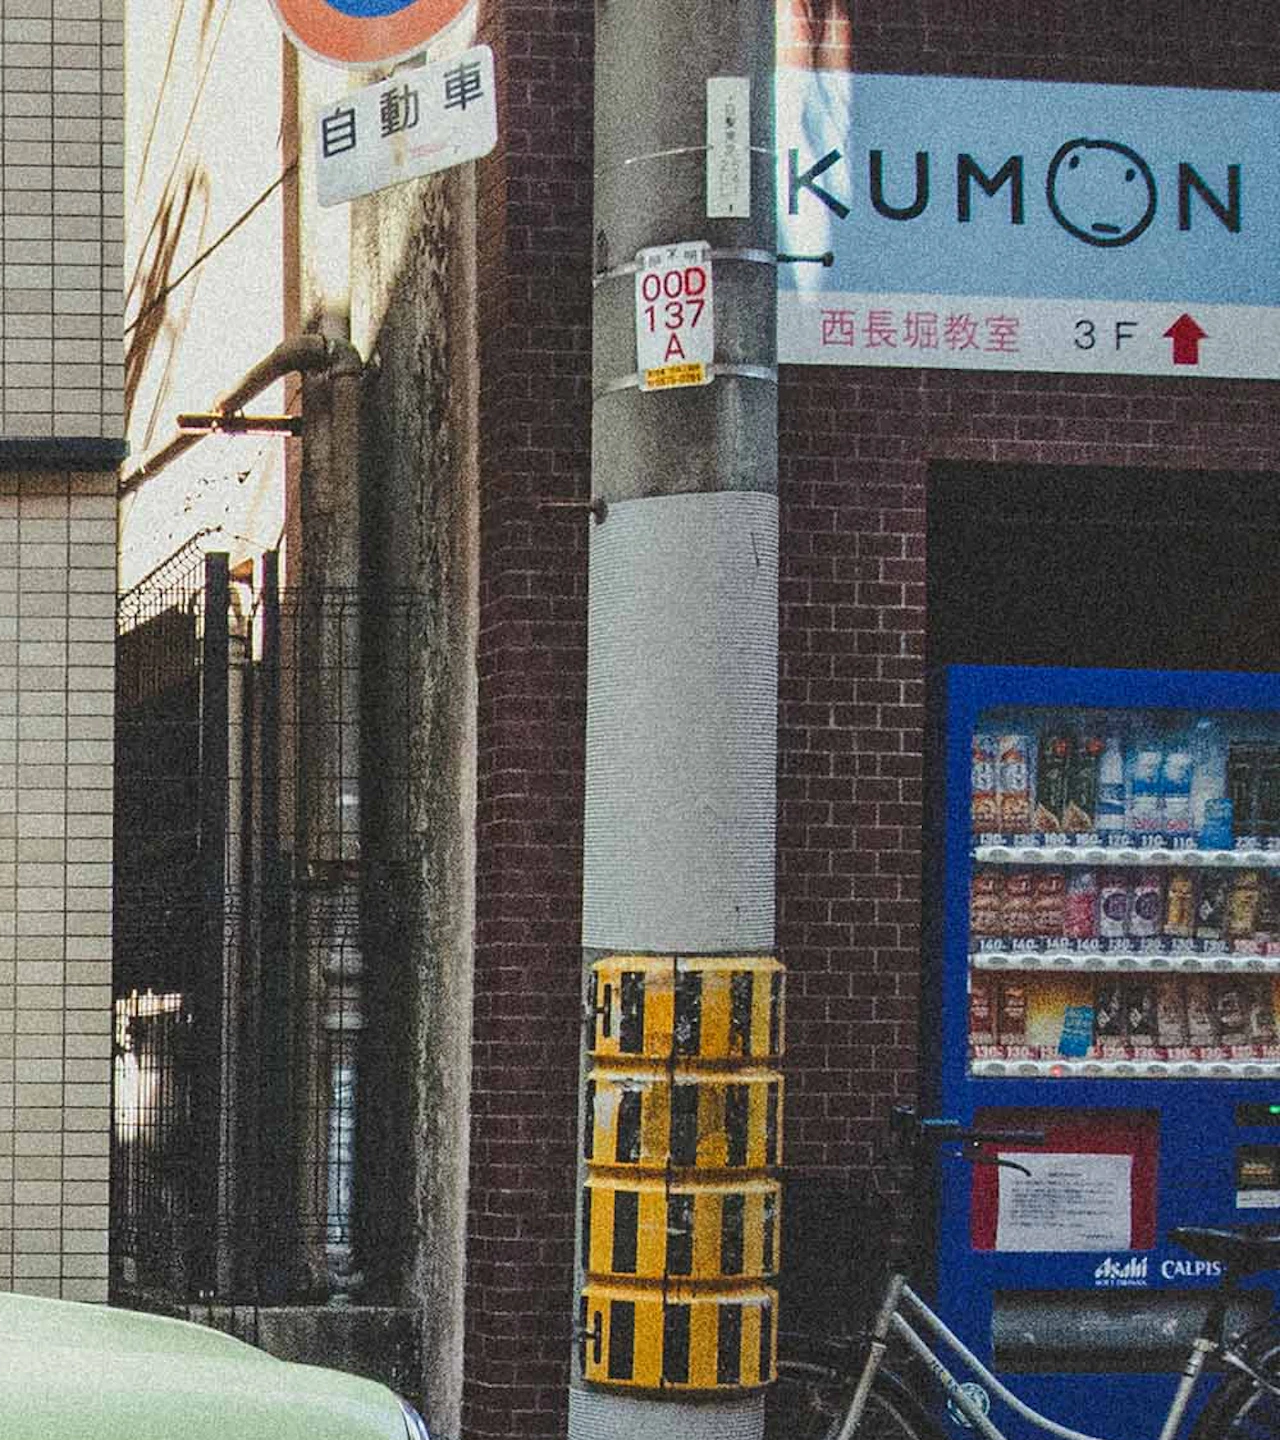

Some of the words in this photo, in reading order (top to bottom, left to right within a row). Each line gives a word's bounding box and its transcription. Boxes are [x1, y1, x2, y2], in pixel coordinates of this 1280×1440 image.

[321, 60, 485, 159] 自動車
[787, 136, 1242, 248] KUMON
[645, 300, 705, 332] 137
[819, 308, 1021, 353] 西長堀教室
[664, 332, 686, 362] A
[1094, 1256, 1148, 1279] Asahi
[1161, 1259, 1222, 1280] CALPIS
